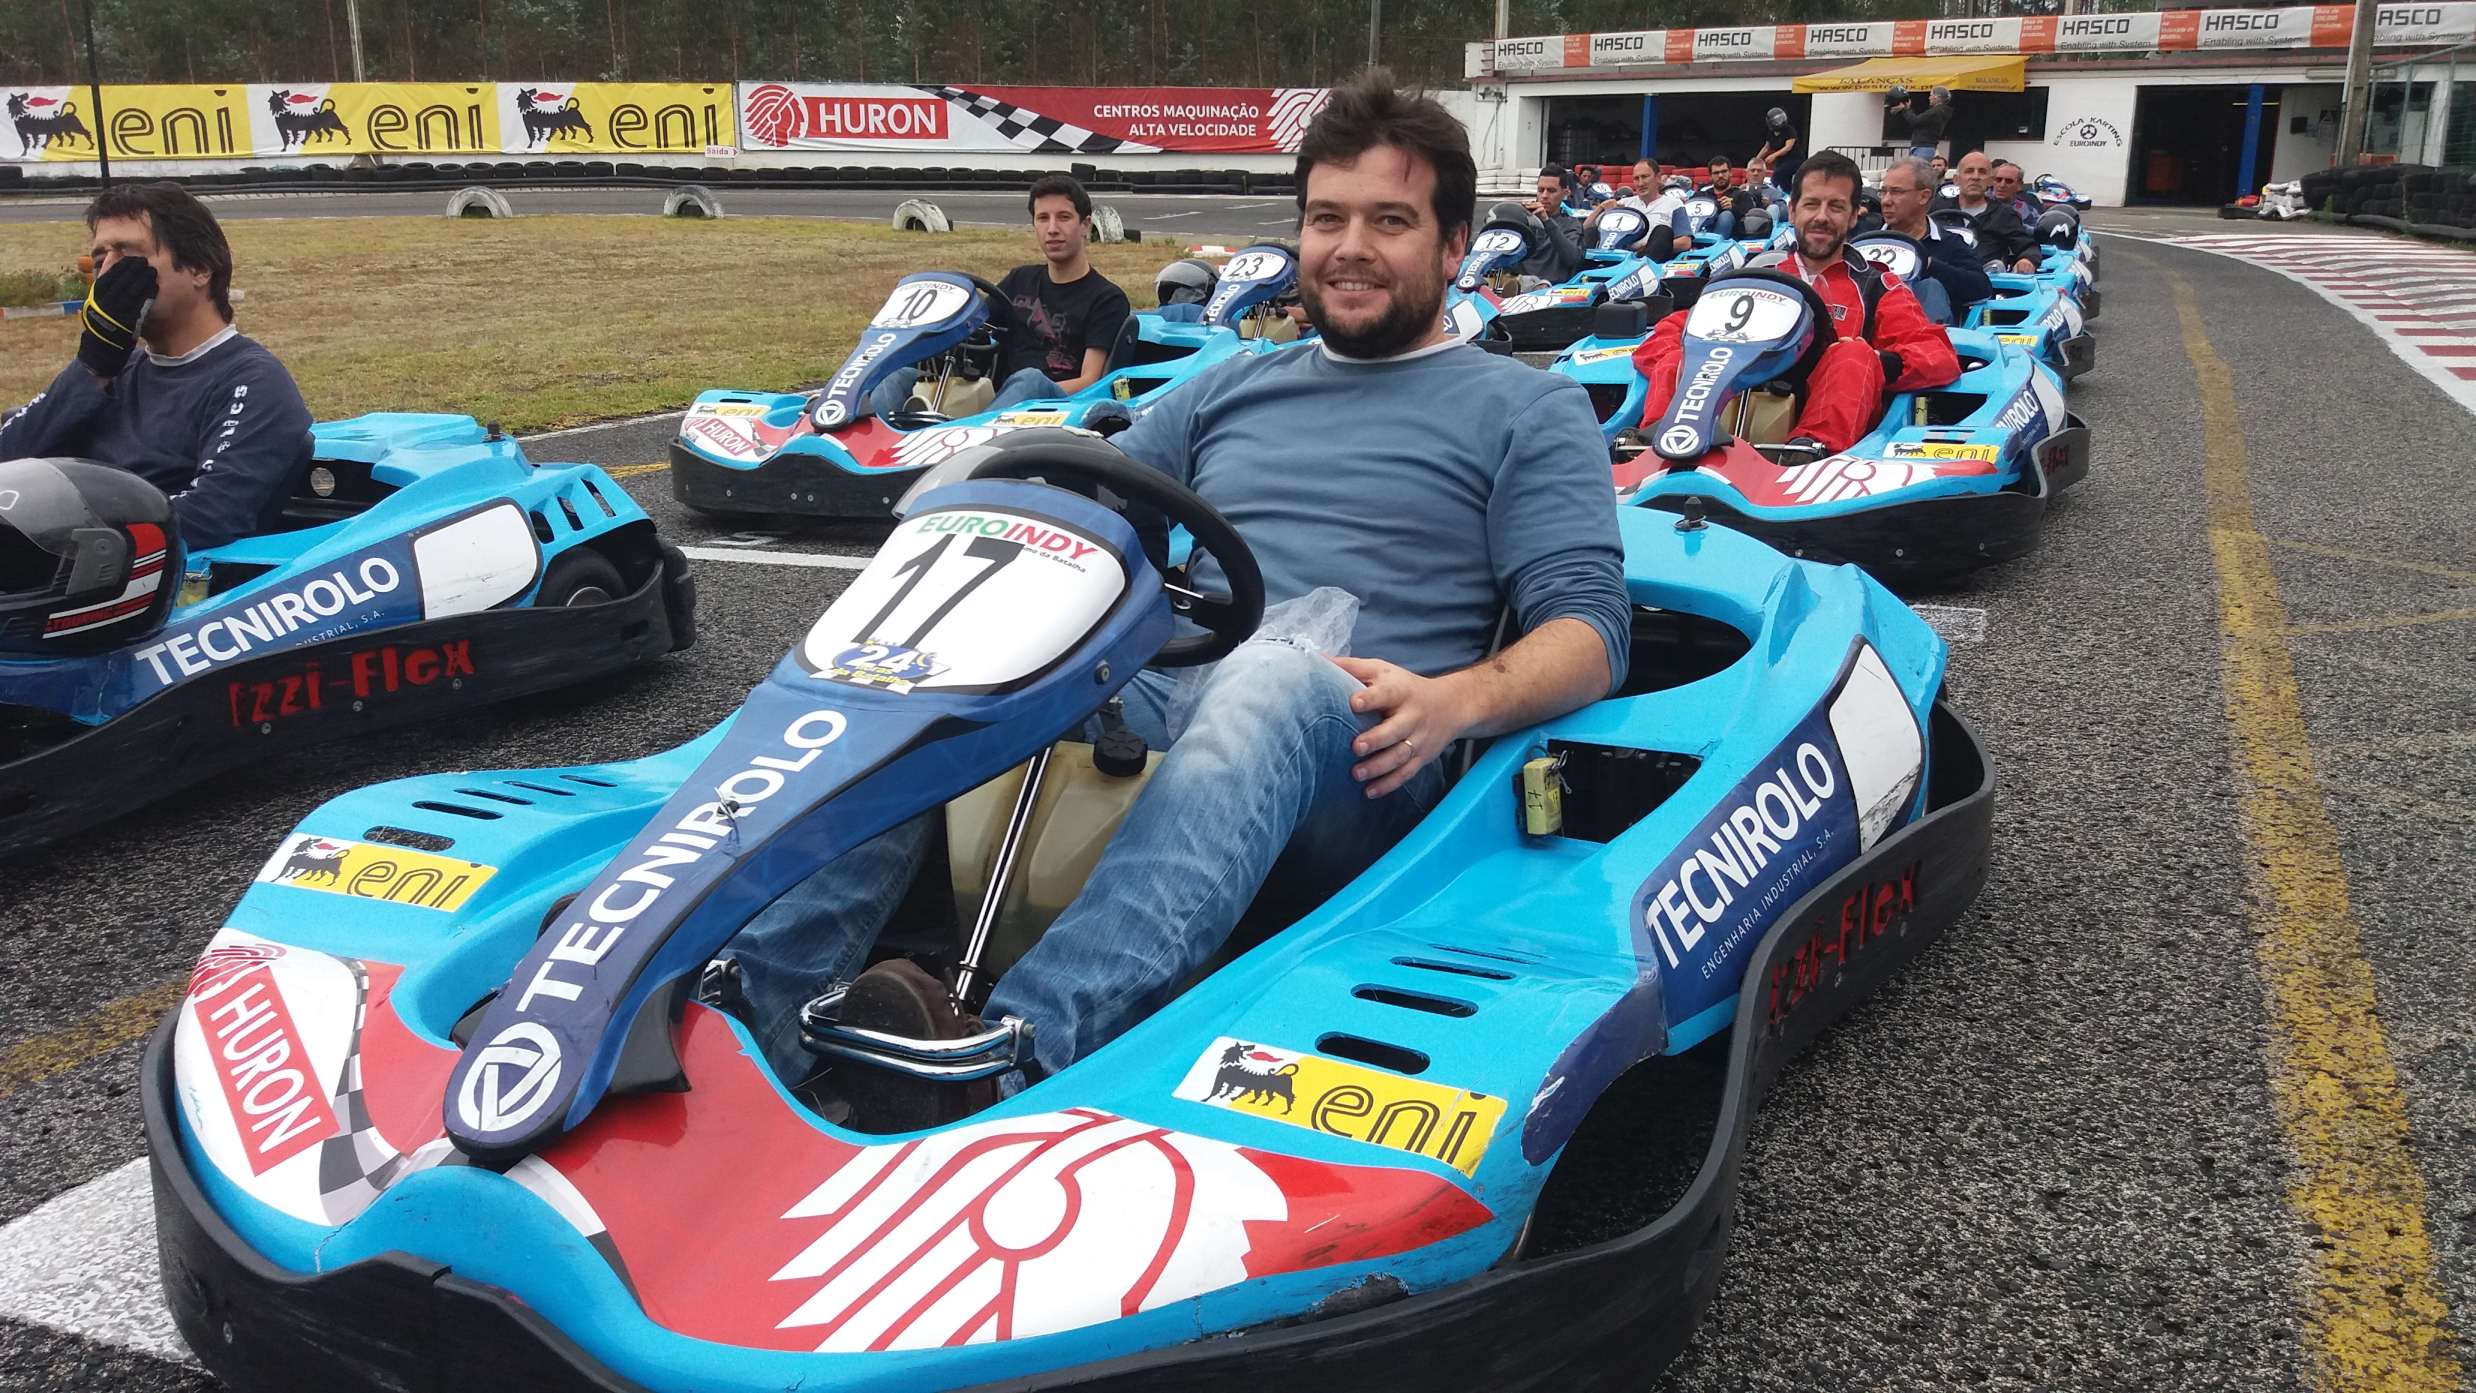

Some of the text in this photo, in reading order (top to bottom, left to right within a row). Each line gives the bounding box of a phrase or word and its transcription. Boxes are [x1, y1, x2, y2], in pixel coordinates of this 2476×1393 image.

[1931, 24, 1993, 39] HASCO
[2062, 18, 2130, 35] HASCO
[2205, 14, 2279, 31] HASCO
[2378, 9, 2441, 26] ASCO
[1498, 42, 1543, 57] HASCO
[1594, 37, 1643, 51] HASCO
[1698, 32, 1751, 47] HASCO
[1810, 28, 1867, 43] HASCO
[110, 89, 236, 155] eni
[367, 87, 480, 151] eni
[608, 87, 717, 149] eni
[818, 102, 938, 136] HURON
[1093, 101, 1260, 121] CENTROS MAQUINAÇÃO
[1129, 122, 1257, 137] ALTA VELOCIDADE
[2053, 118, 2084, 146] ESCOLA
[2090, 117, 2123, 147] KARTING
[1616, 215, 1624, 229] 1
[1694, 202, 1702, 214] 5
[1485, 236, 1510, 247] 12
[1228, 256, 1264, 277] 23
[1609, 274, 1640, 300] ECNIROLO
[896, 288, 938, 321] 10
[1724, 295, 1755, 333] 9
[828, 332, 897, 400] TECNIROLO
[1675, 347, 1734, 423] TECNIROLO
[701, 422, 750, 454] HURON
[1933, 444, 1993, 461] eni
[917, 515, 1098, 561] EUROINDY
[850, 533, 1026, 650] 17
[135, 557, 400, 687] TECNIROLO
[845, 645, 921, 675] 24
[519, 708, 848, 1011] TECNIROLO
[1646, 742, 1836, 969] TECNIROLO
[346, 863, 486, 910] eni
[1701, 909, 1762, 981] ENGENHARIA
[1816, 830, 1836, 850] S.A.
[209, 982, 323, 1155] HURON
[1311, 1084, 1488, 1165] eni
